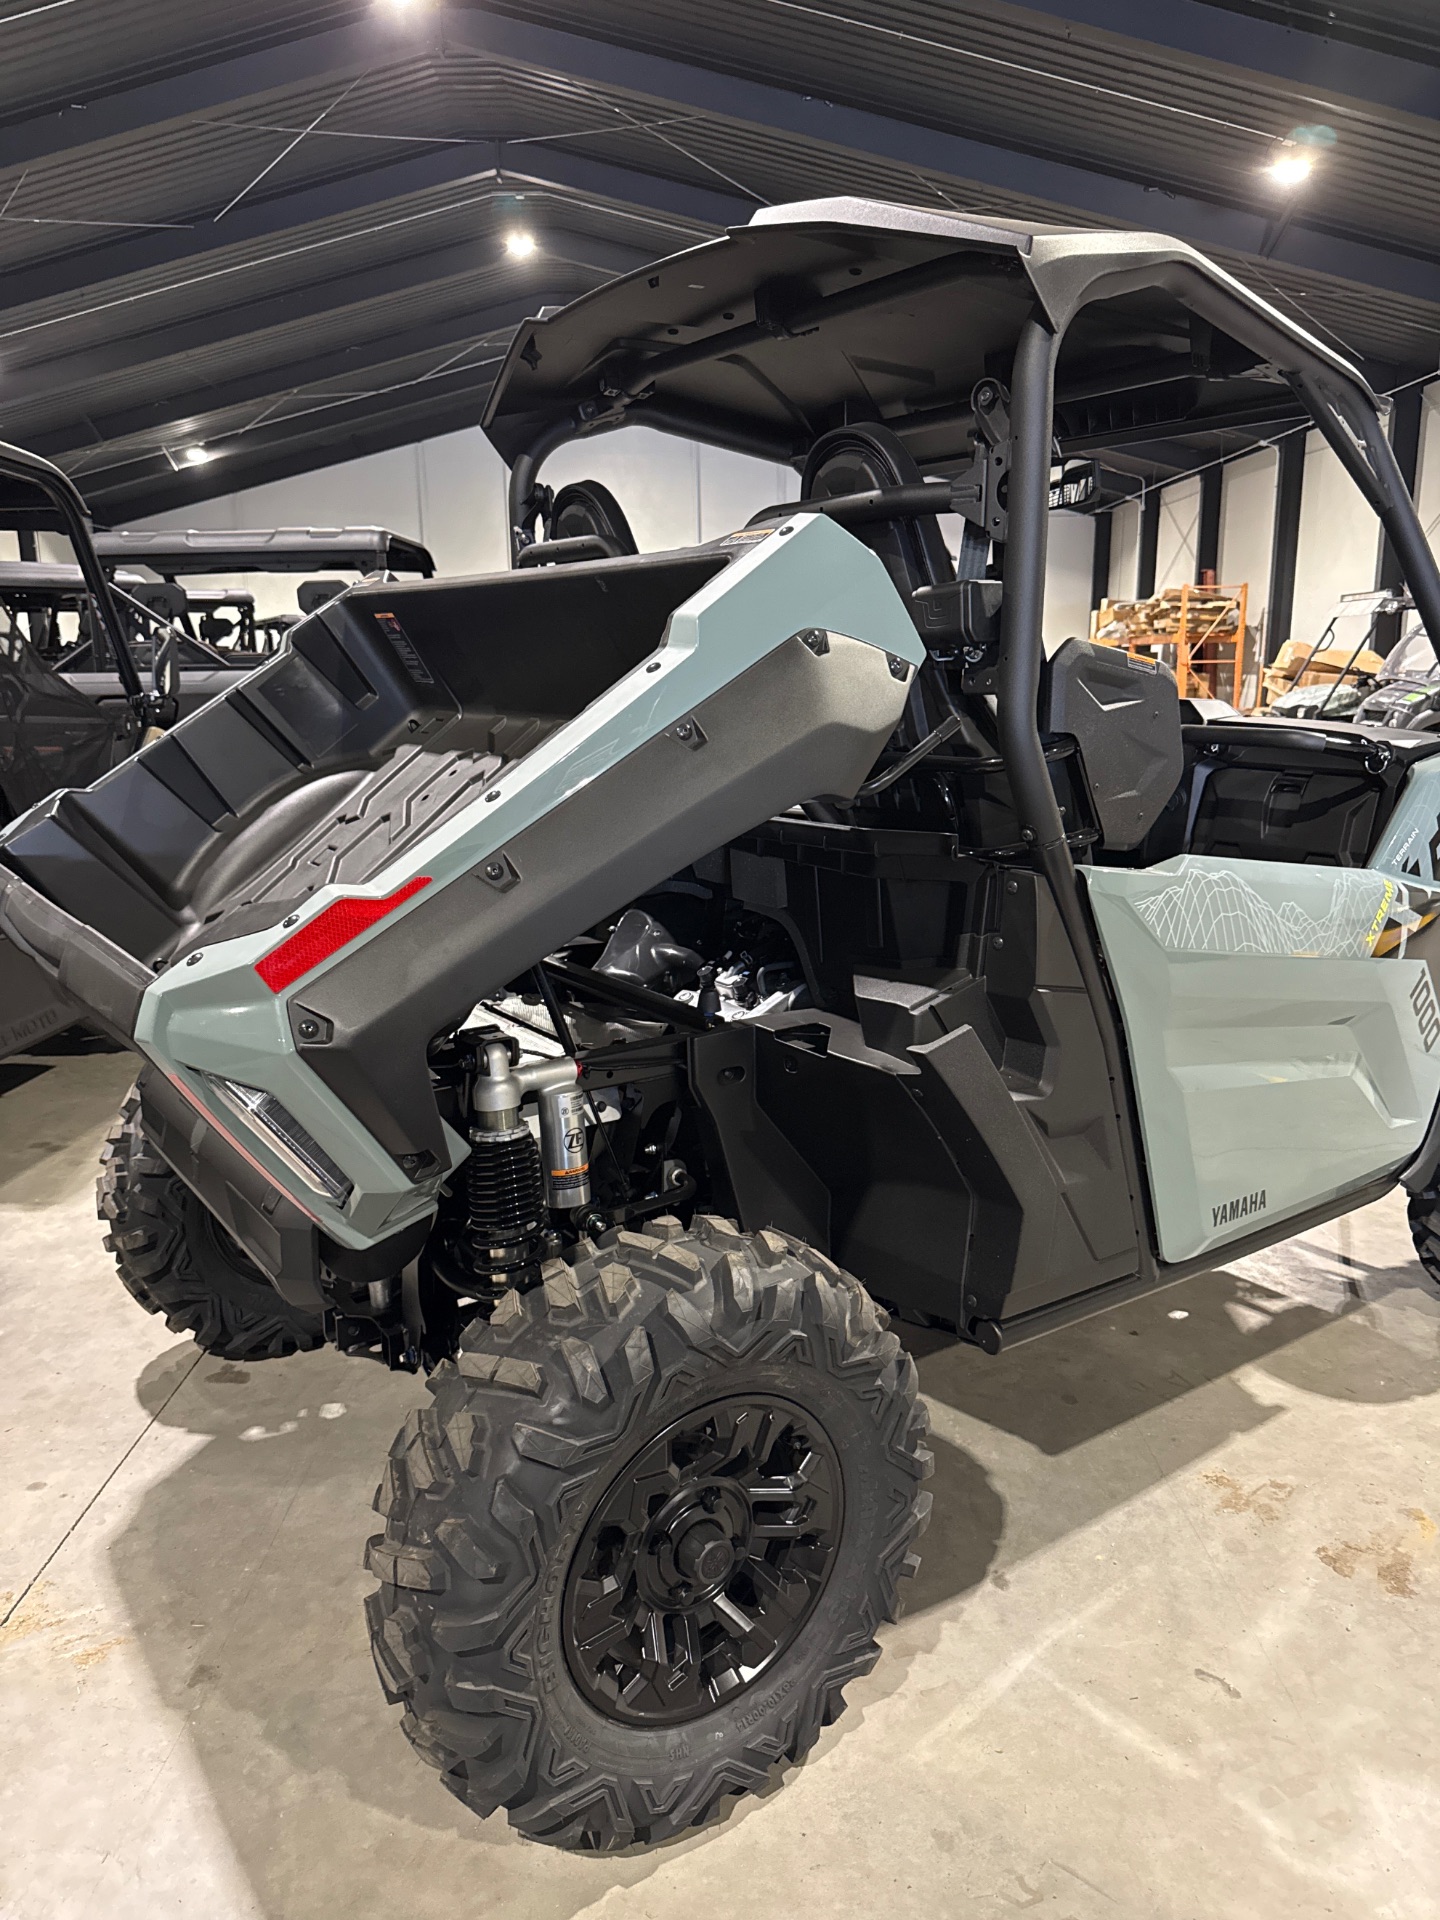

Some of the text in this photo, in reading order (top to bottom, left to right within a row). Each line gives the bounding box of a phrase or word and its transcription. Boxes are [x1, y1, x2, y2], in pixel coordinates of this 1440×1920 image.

[1391, 827, 1420, 866] TERRAIN
[1365, 878, 1394, 947] XTREME
[1409, 967, 1440, 1053] 1000
[565, 1130, 583, 1151] ZF
[1212, 1189, 1267, 1228] YAMAHA
